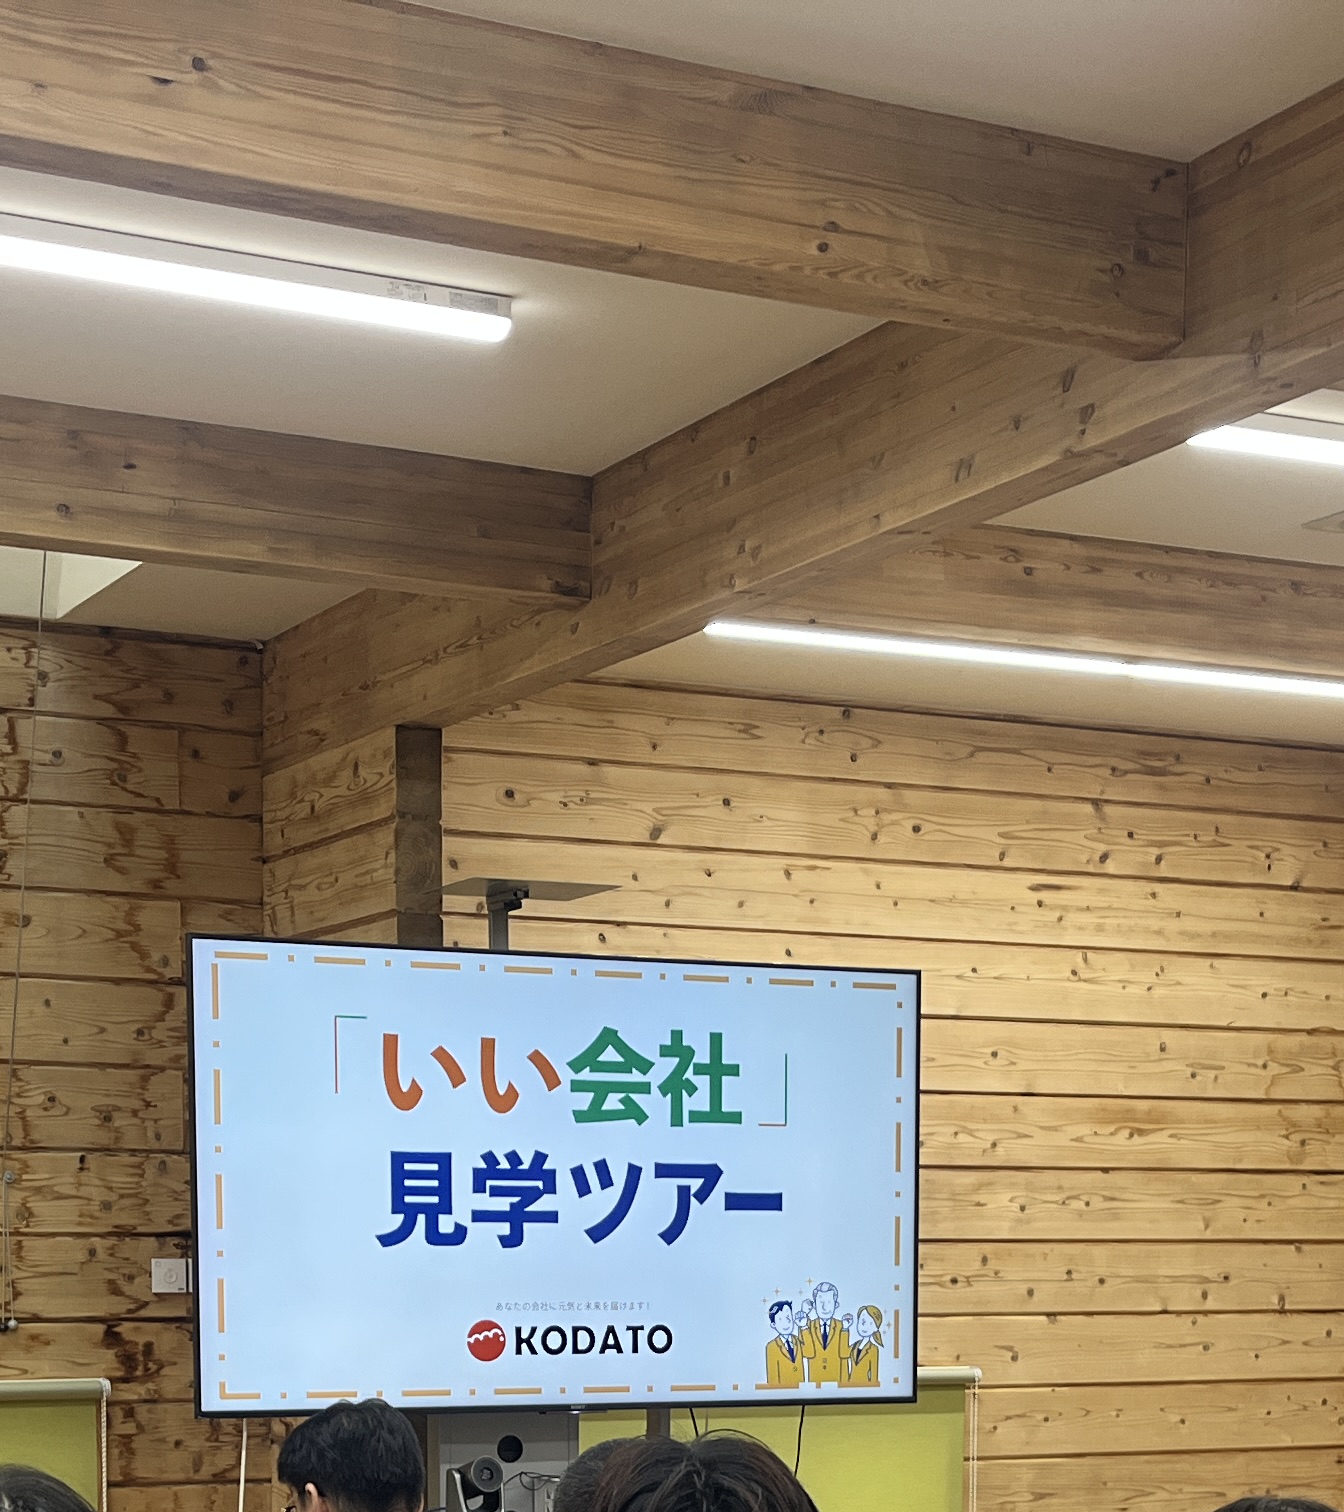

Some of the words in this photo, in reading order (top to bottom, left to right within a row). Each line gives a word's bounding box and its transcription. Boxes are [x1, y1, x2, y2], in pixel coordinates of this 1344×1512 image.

[335, 1015, 787, 1127] 「いい会社」
[375, 1150, 783, 1248] 見学ツアー
[515, 1324, 673, 1355] KODATO
